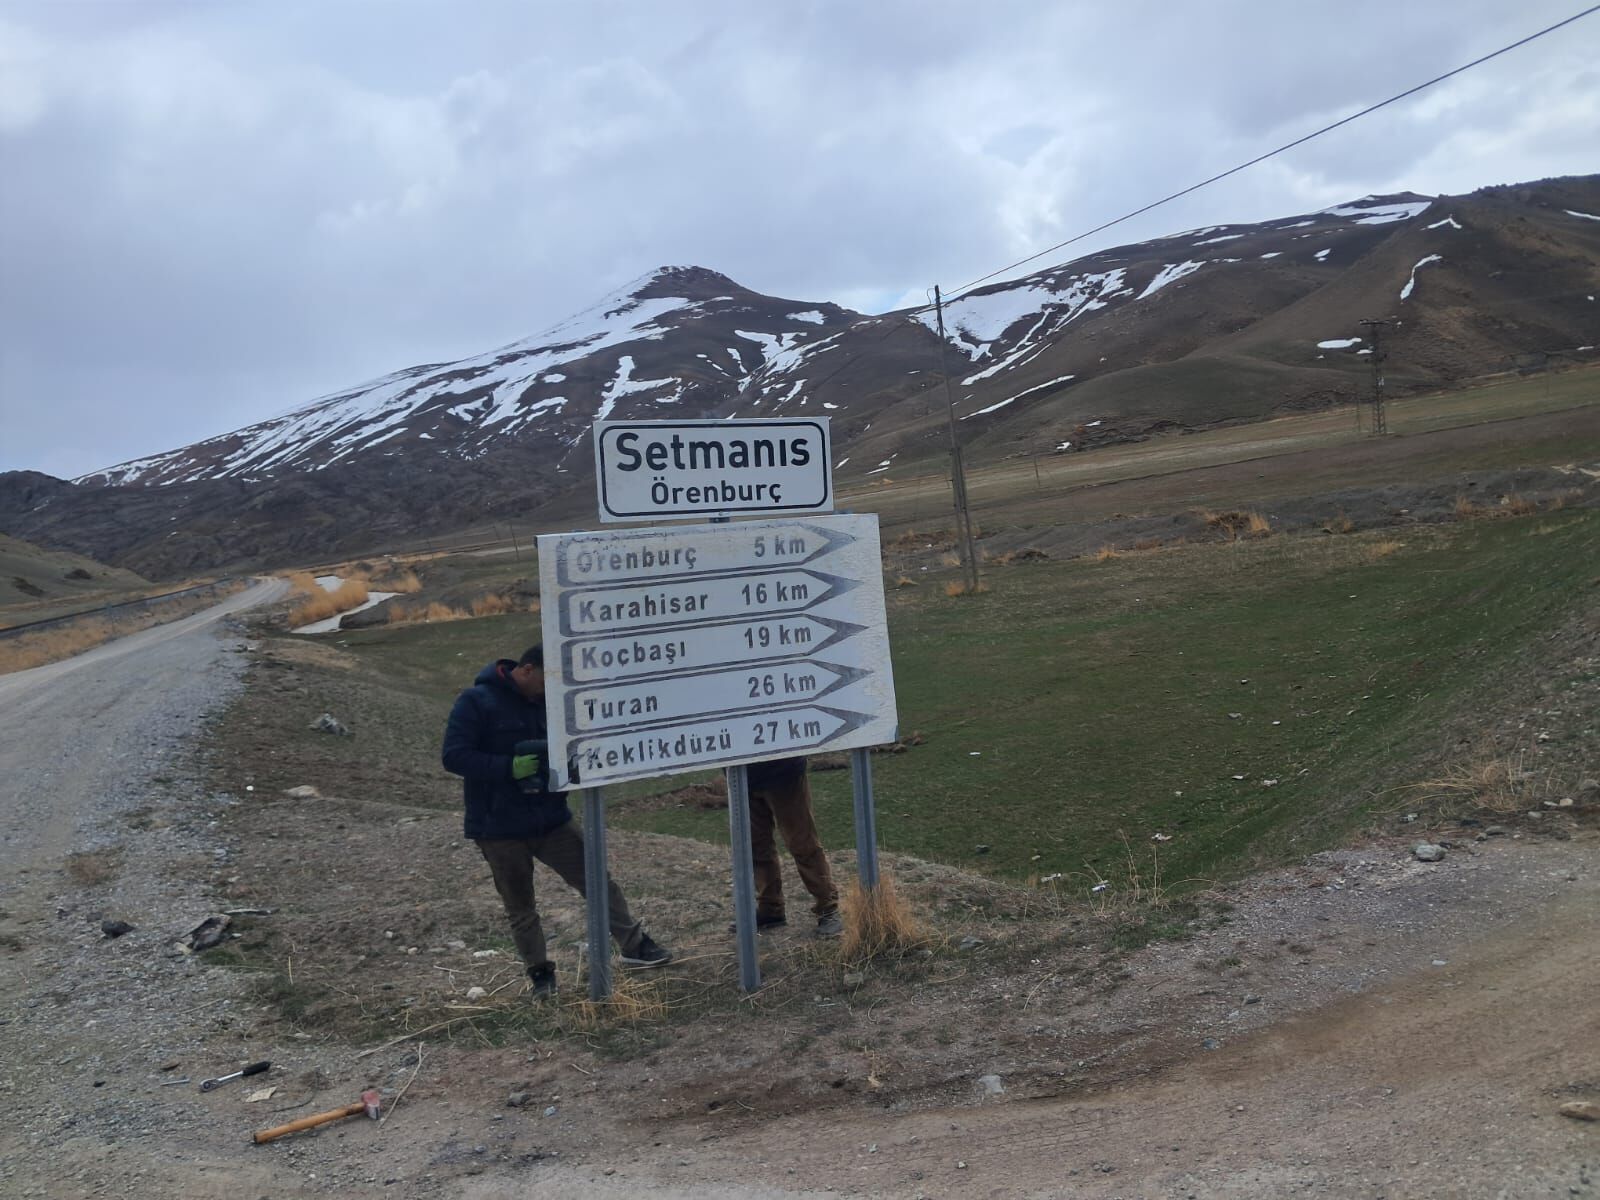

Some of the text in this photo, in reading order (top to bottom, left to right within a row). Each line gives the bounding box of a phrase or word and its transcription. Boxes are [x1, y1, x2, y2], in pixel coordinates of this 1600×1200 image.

[616, 432, 810, 471] Setmanıs
[651, 476, 782, 504] Örenburç
[754, 536, 766, 557] 5
[774, 536, 806, 555] km
[579, 581, 808, 623] Karahisar 16 km
[744, 626, 770, 648] 19
[779, 624, 811, 645] km
[583, 673, 816, 720] Turan 26 km
[587, 719, 821, 770] Keklikdüzü 27 km
